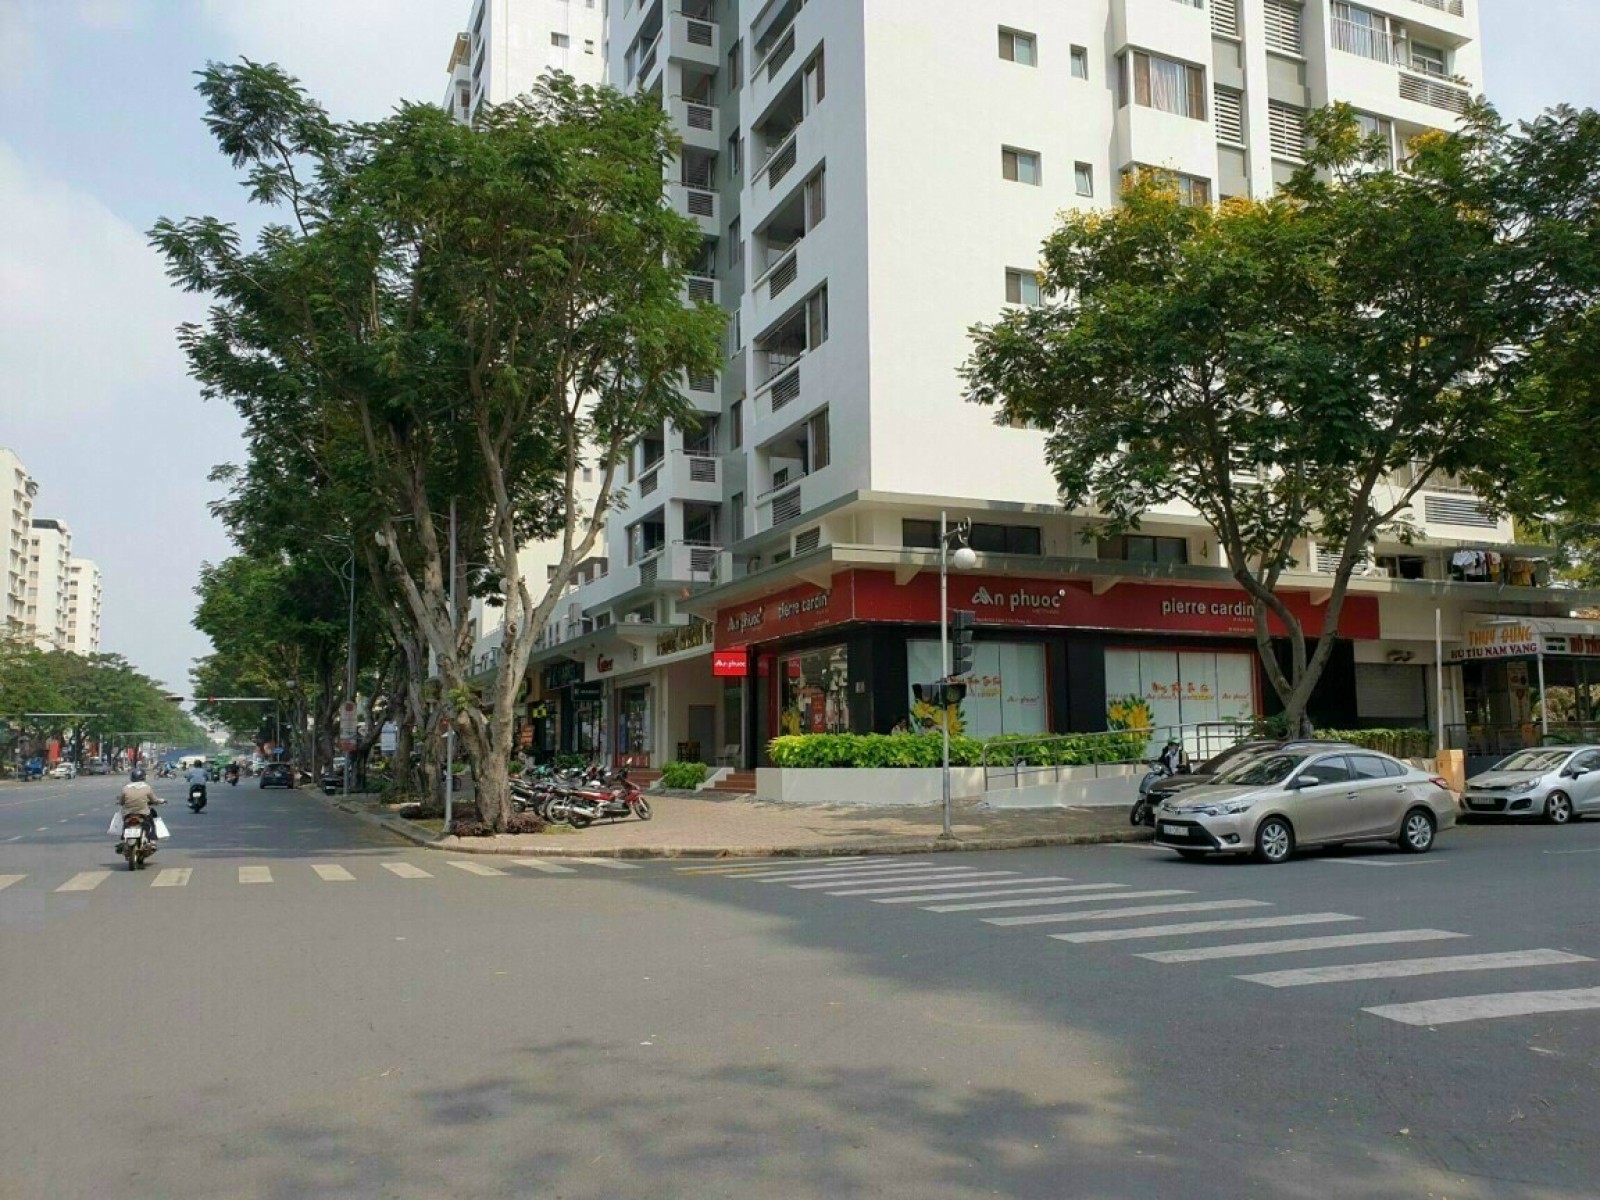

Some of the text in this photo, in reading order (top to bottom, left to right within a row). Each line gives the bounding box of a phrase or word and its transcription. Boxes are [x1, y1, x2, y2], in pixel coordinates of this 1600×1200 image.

[802, 595, 828, 612] cardin
[971, 586, 1004, 605] An
[1162, 598, 1255, 616] pierre cardin
[1485, 645, 1507, 656] NAM
[1509, 642, 1537, 654] VANG
